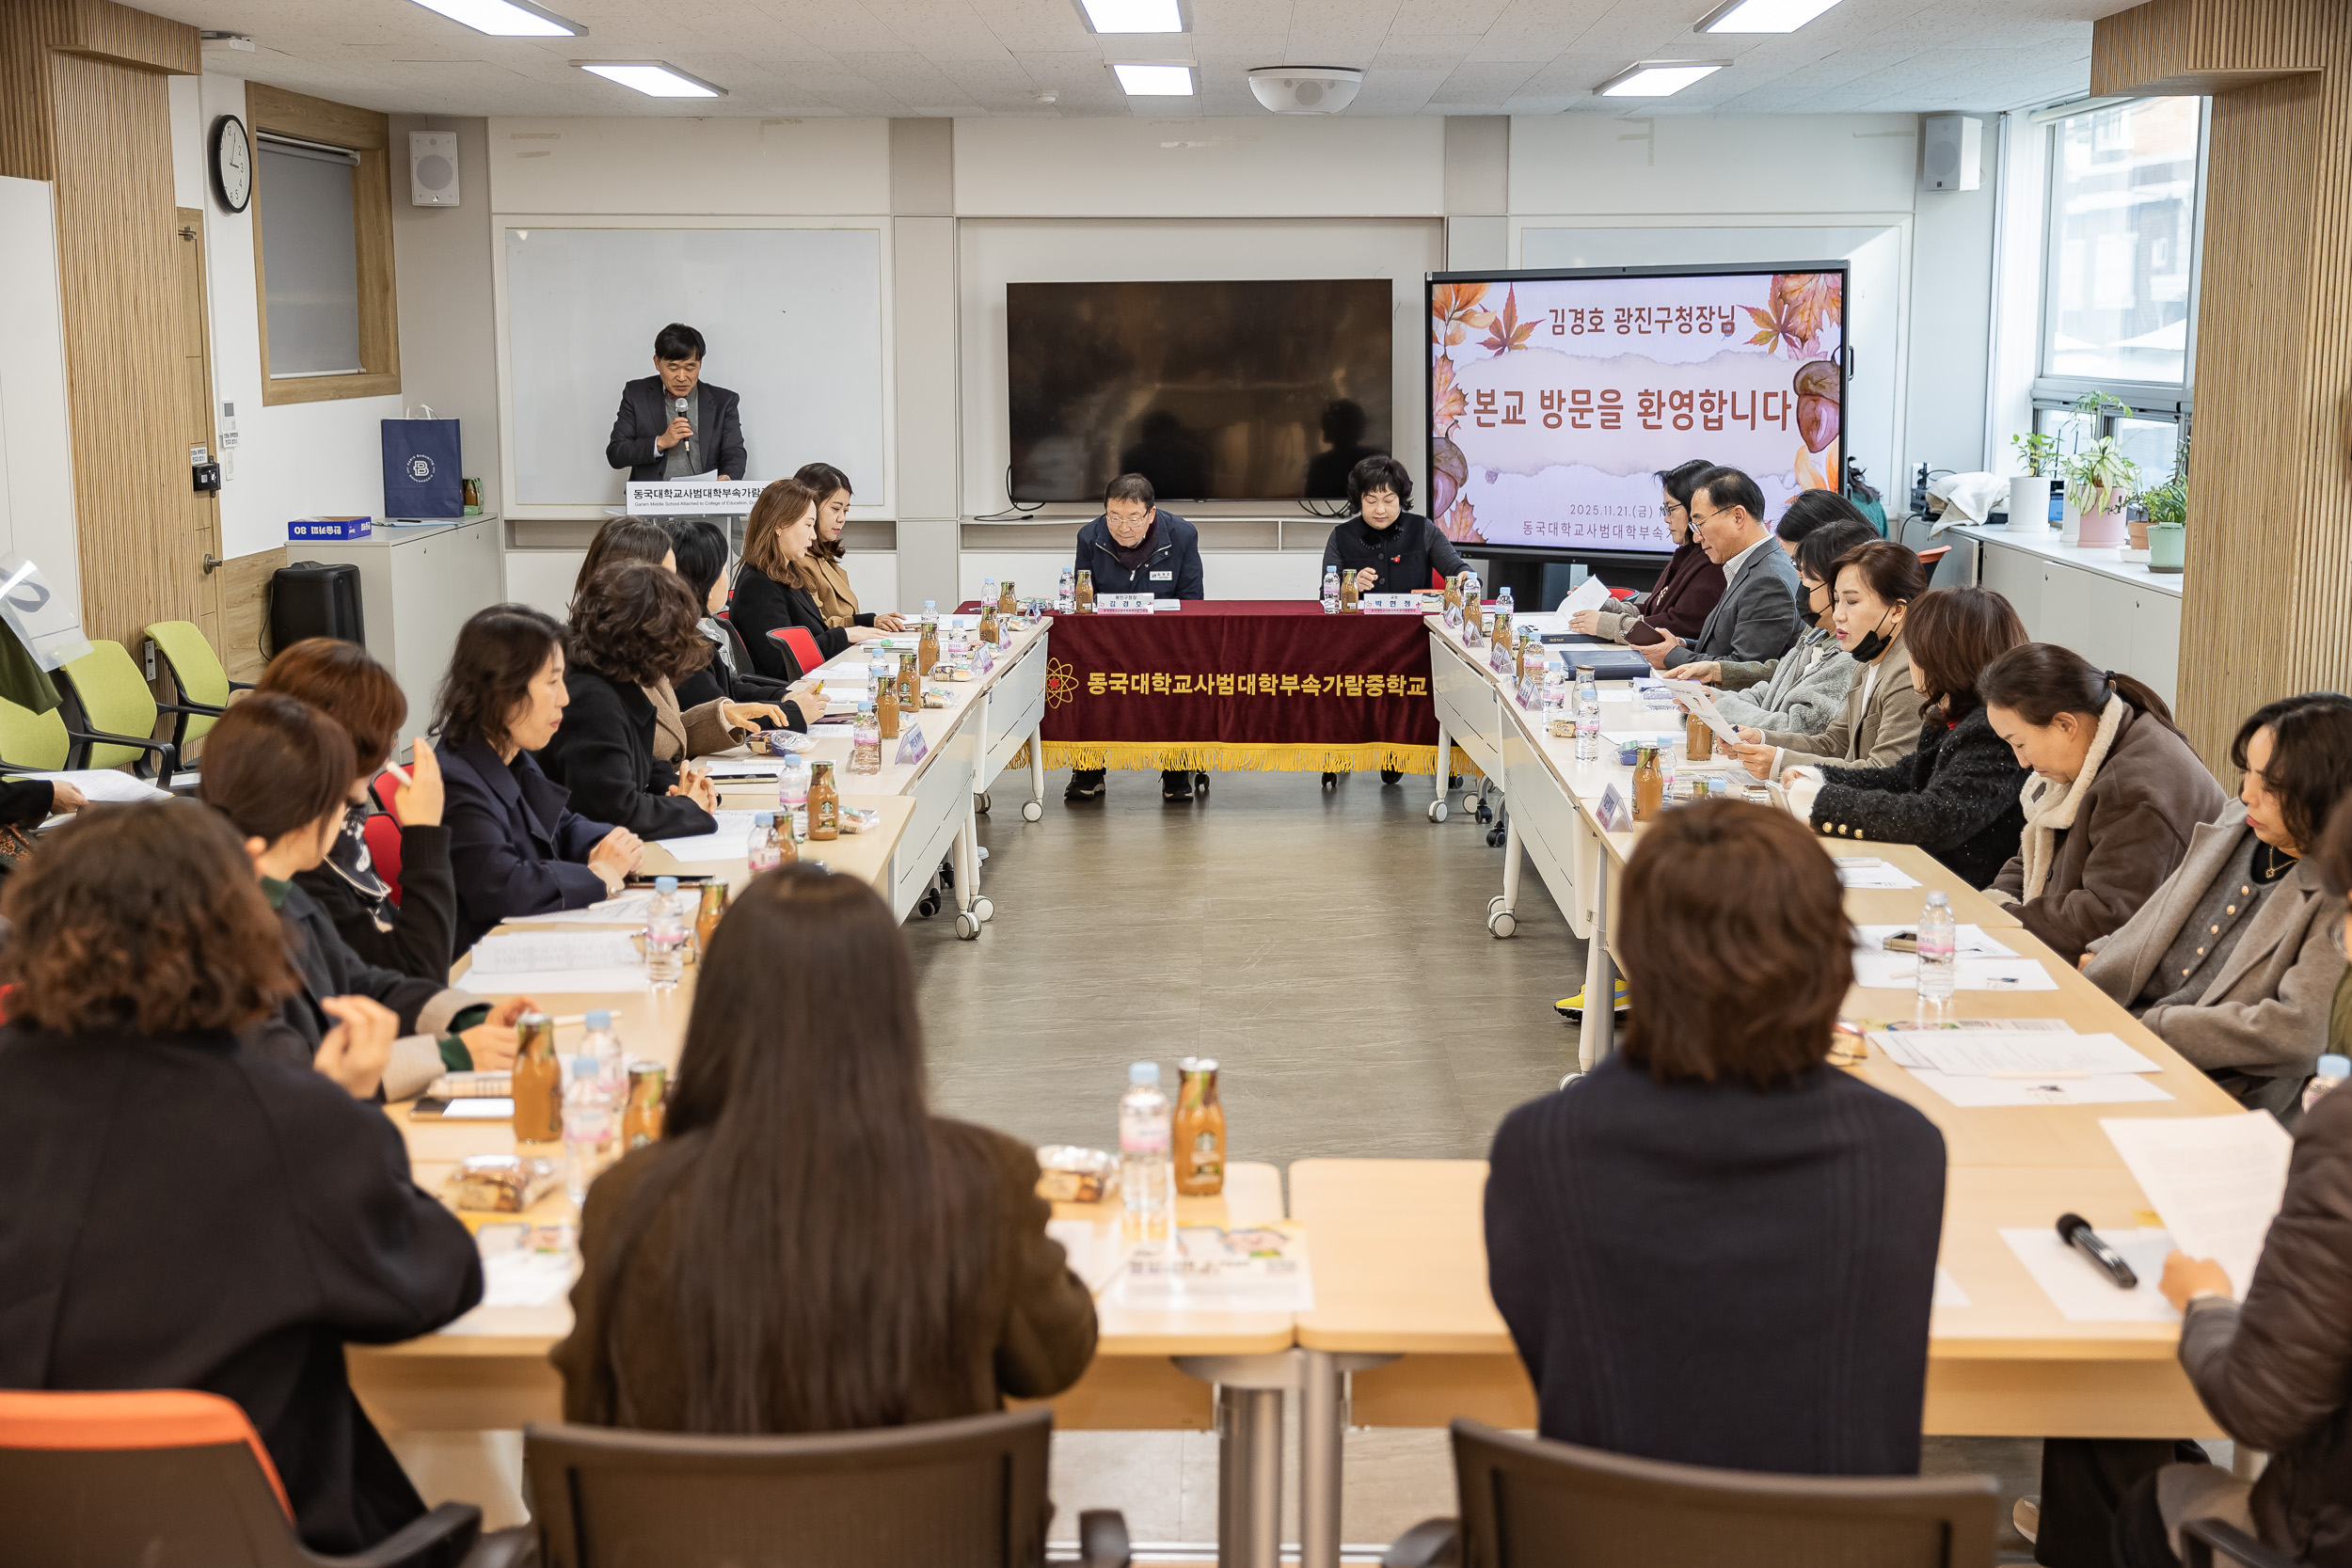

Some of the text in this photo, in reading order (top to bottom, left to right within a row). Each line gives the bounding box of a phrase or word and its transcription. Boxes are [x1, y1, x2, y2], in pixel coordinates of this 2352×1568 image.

[1549, 305, 1736, 336] 김경호 광진구청장님
[1473, 388, 1792, 432] 본교 방문을 환영합니다
[1570, 503, 1653, 518] 2025.11.21.(금)
[294, 526, 307, 535] 80
[1087, 672, 1428, 697] 동국대학교사범대학부속가람중학교
